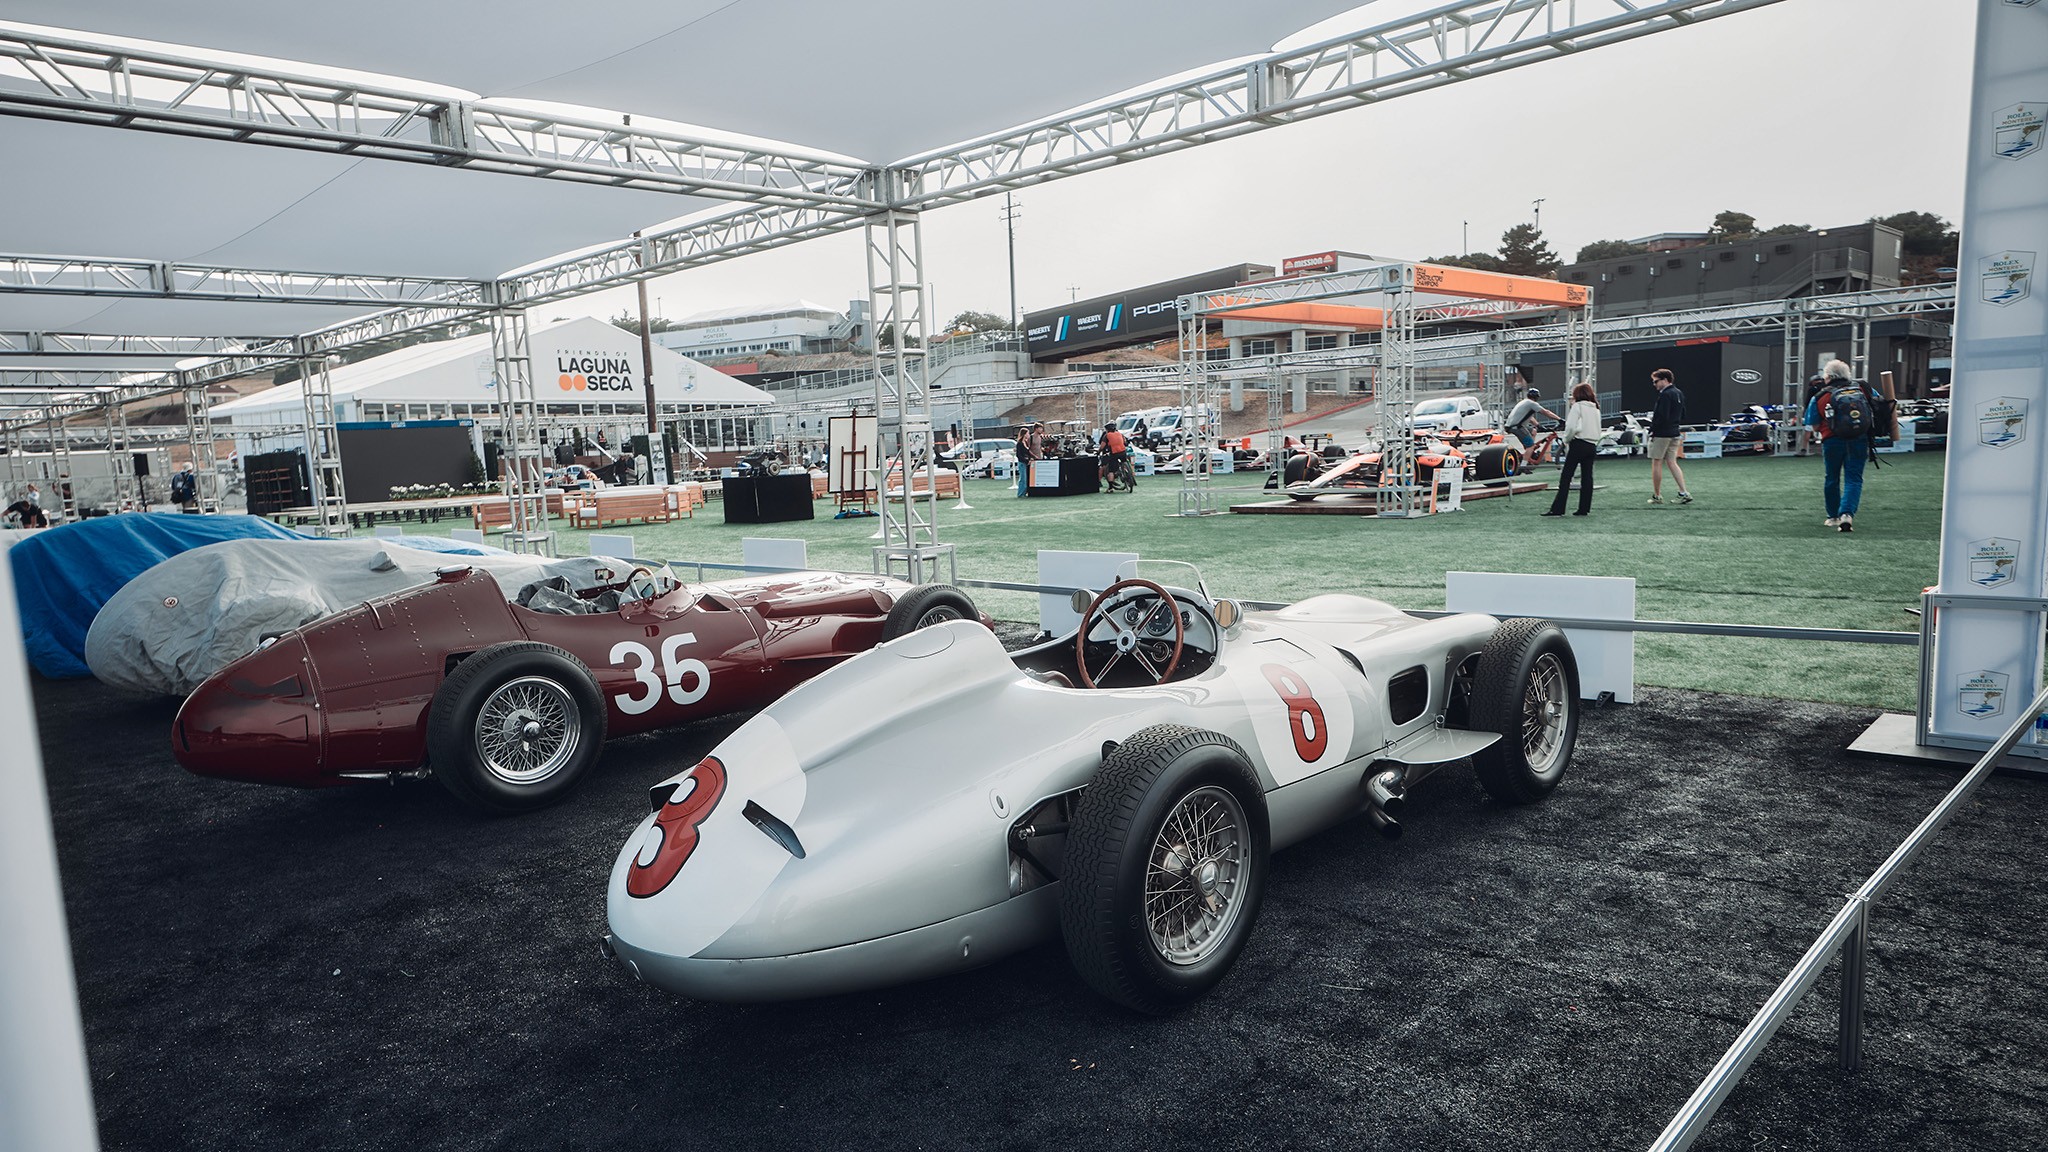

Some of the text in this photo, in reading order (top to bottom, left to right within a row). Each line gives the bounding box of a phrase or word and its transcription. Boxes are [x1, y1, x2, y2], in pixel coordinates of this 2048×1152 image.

[2002, 116, 2037, 125] MONTEREY
[2007, 111, 2033, 119] ROLEX
[1077, 314, 1102, 325] HAGERTY
[1028, 325, 1051, 336] HAGERTY
[558, 357, 632, 374] LAGUNA
[587, 375, 633, 391] SECA
[609, 632, 711, 715] 36
[1261, 663, 1328, 763] 8
[626, 755, 728, 899] 8
